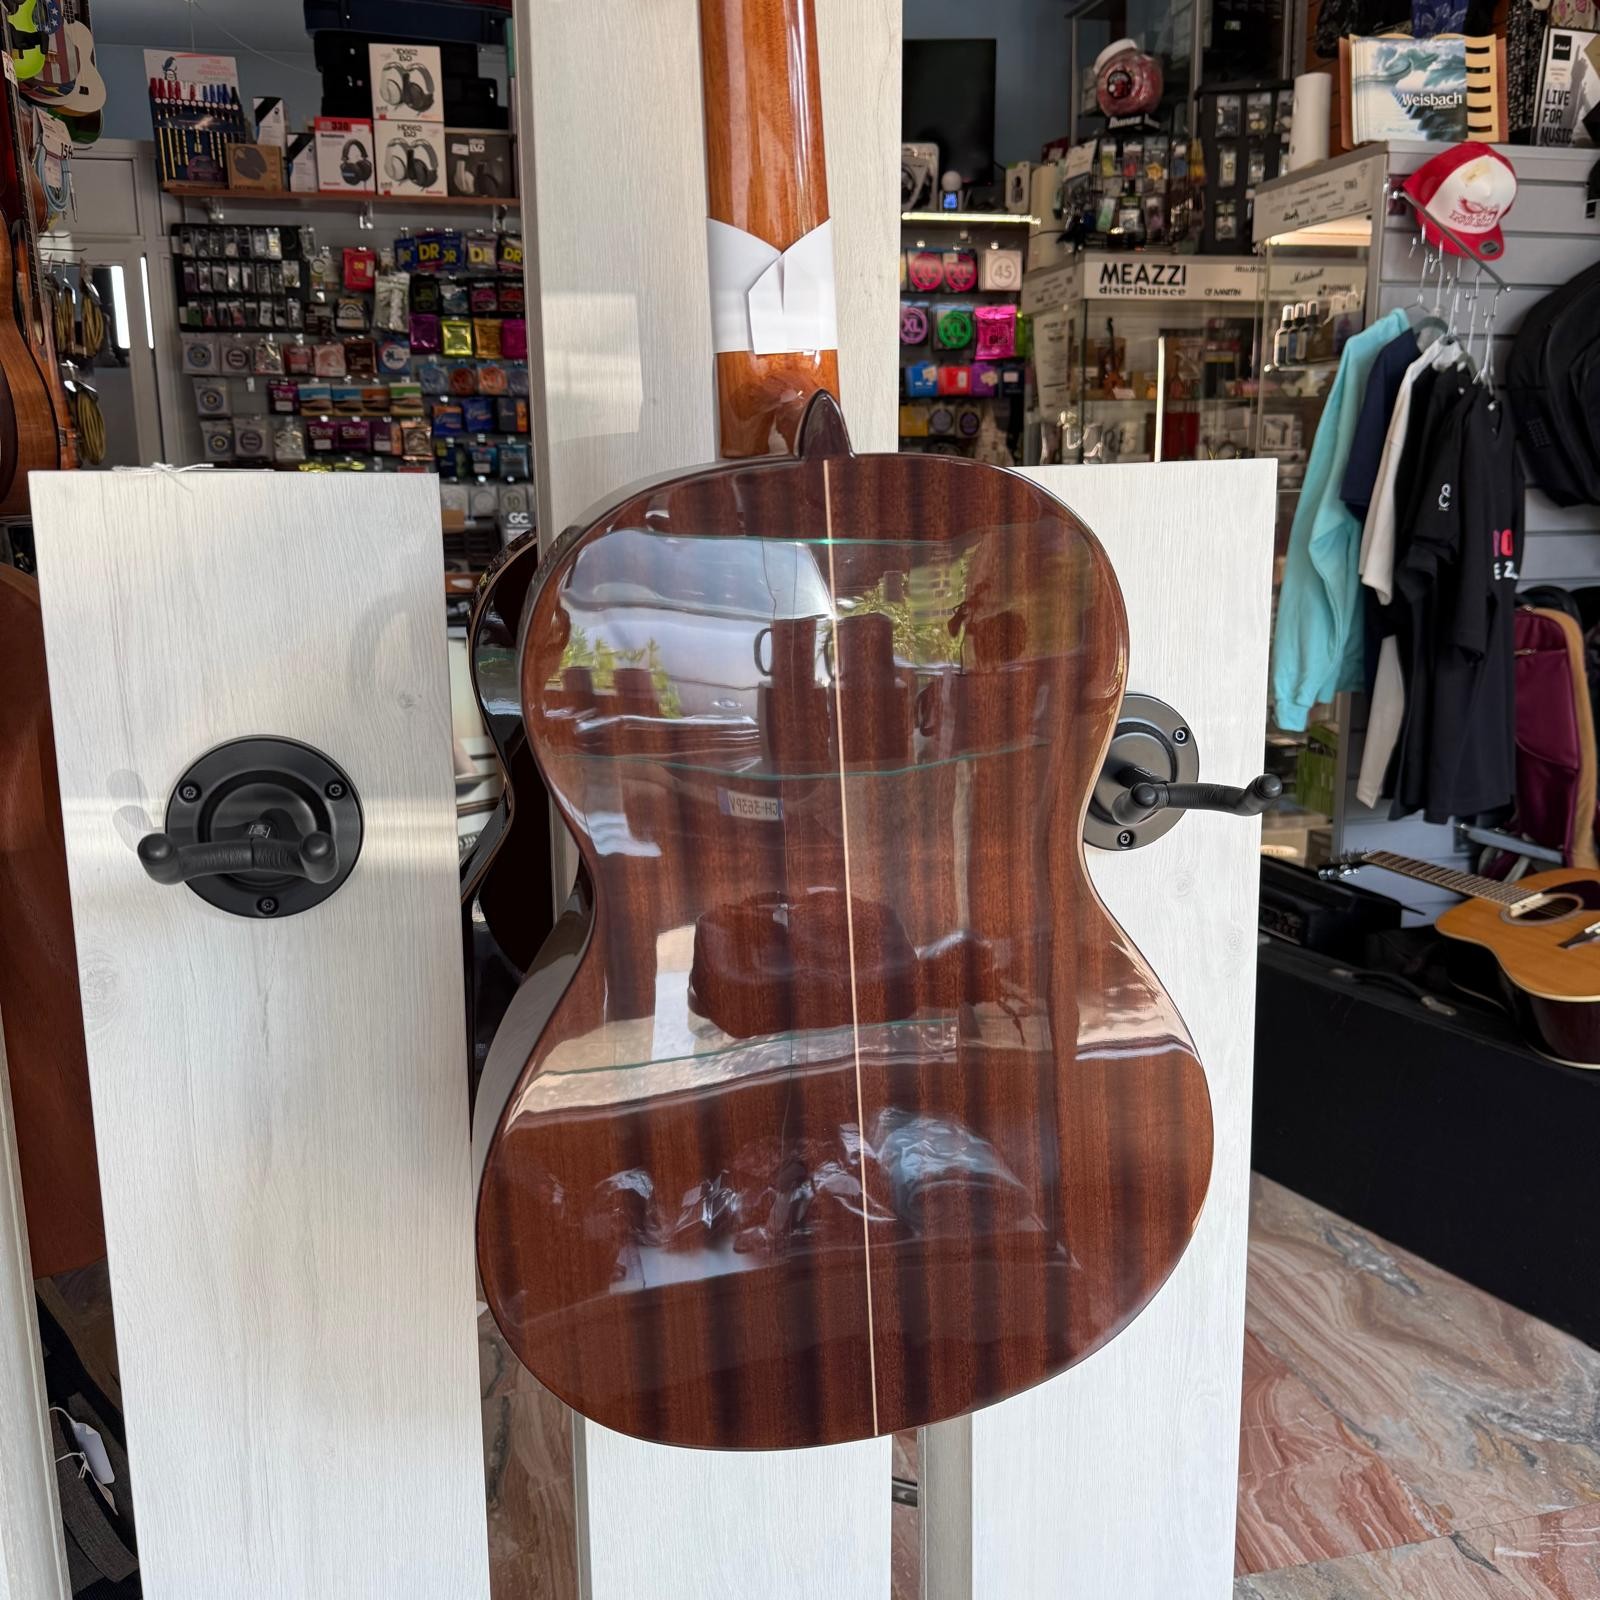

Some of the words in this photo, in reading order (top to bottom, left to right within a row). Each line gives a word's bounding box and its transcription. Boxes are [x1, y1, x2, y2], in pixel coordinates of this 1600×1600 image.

[1402, 92, 1463, 106] Weisbach
[1545, 89, 1571, 106] LIVE
[1543, 109, 1563, 124] FOR
[418, 243, 440, 261] DR
[503, 247, 522, 263] DR
[1099, 263, 1187, 286] MEAZZI
[1099, 285, 1186, 296] distribuisce
[506, 496, 520, 508] 10
[508, 512, 529, 524] GC
